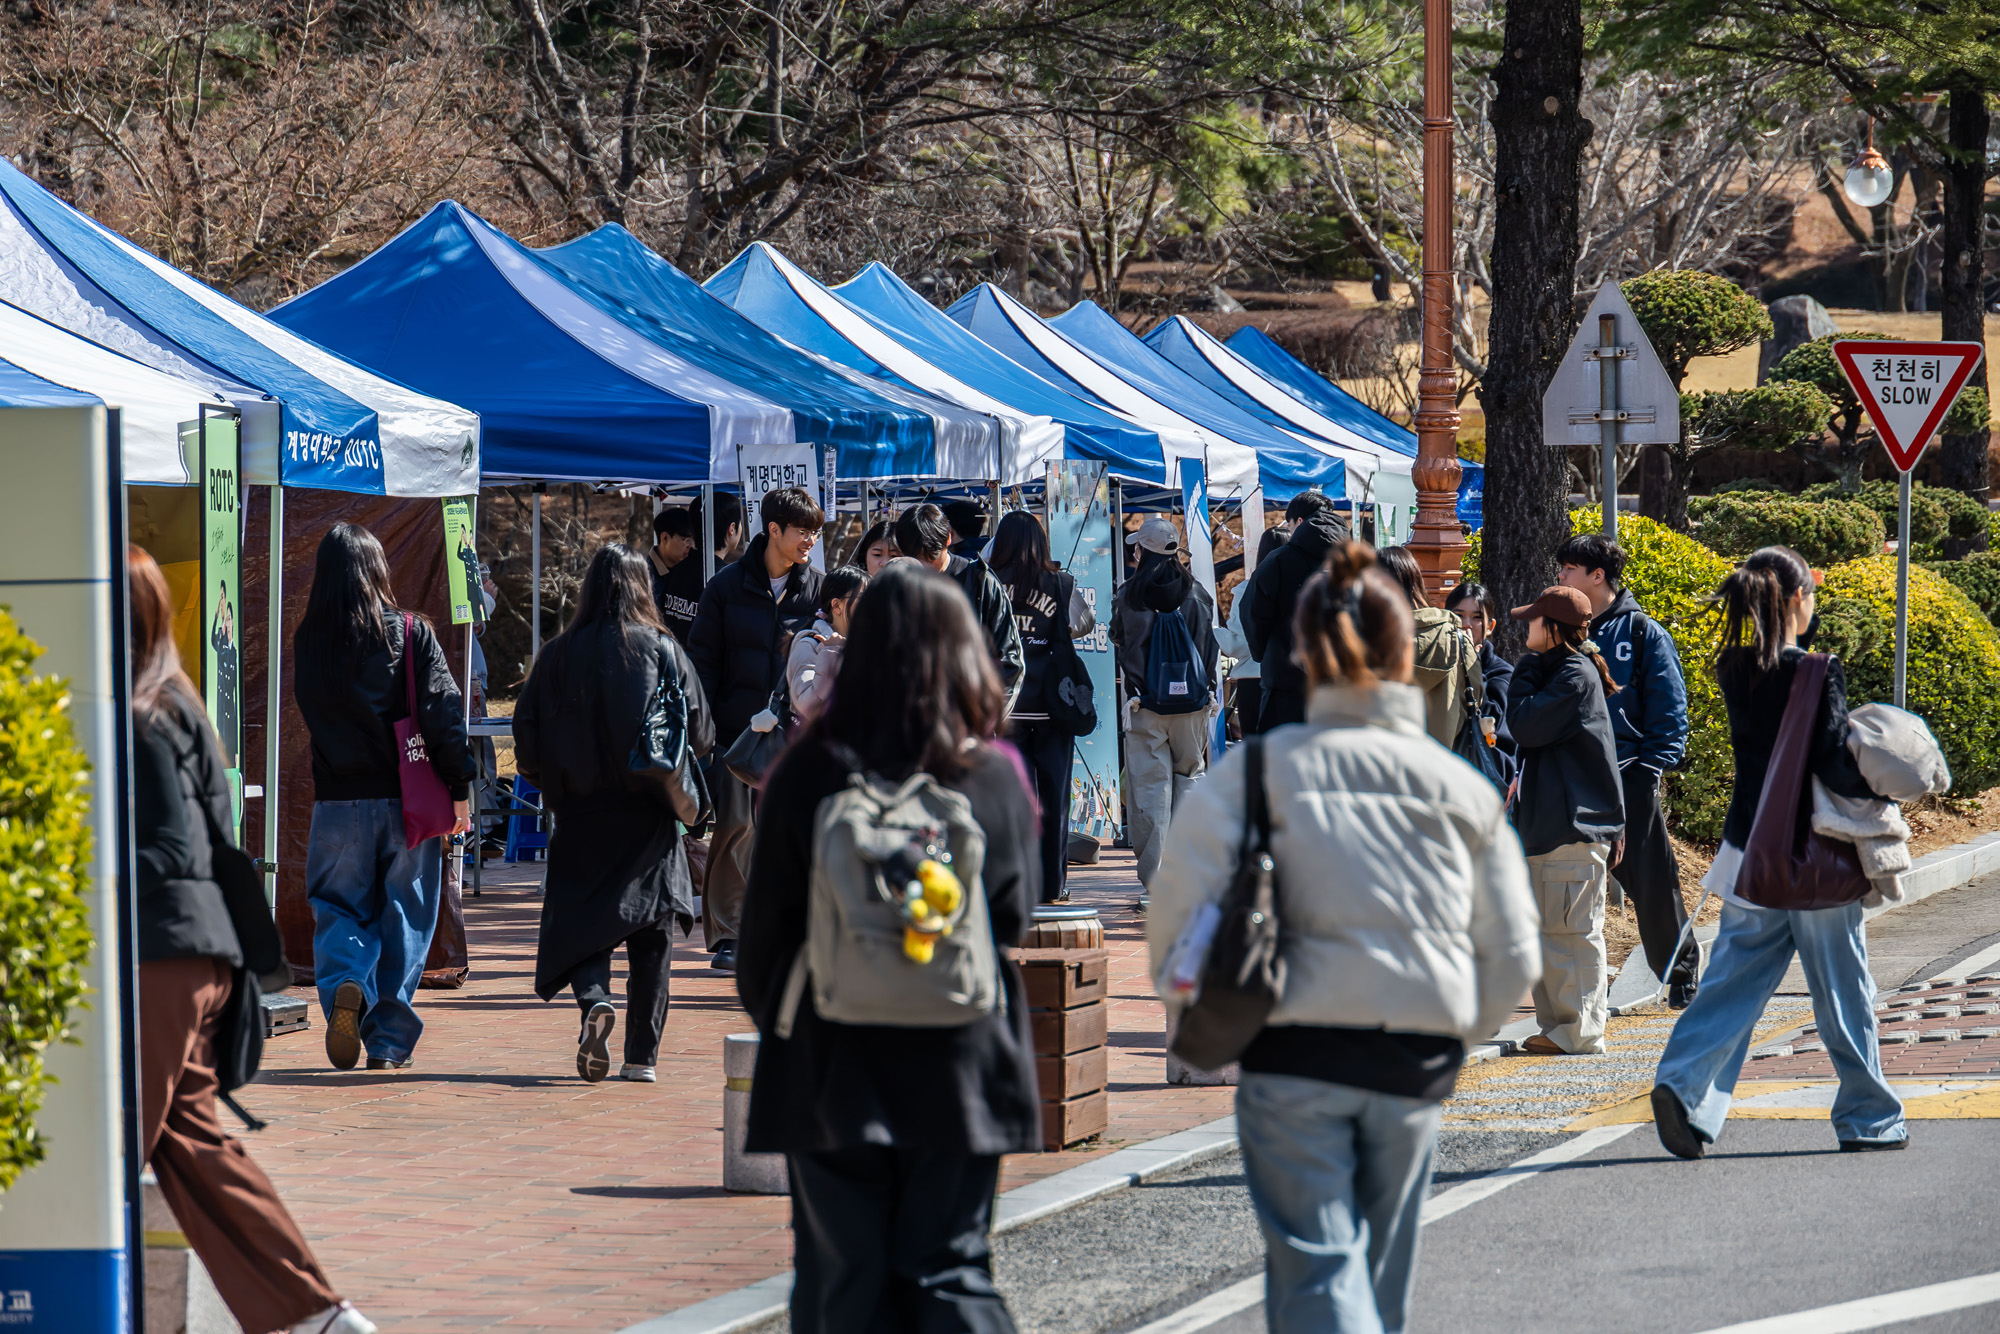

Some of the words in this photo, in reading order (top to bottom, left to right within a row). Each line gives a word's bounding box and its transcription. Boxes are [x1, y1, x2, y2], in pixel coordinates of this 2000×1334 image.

[1872, 358, 1940, 383] 천천히
[1881, 386, 1931, 404] SLOW
[288, 430, 341, 464] 계명대학교
[344, 438, 379, 470] ROTC
[746, 464, 808, 493] 계명대학교
[210, 468, 233, 513] ROTC
[1013, 614, 1036, 632] IV.
[1615, 641, 1632, 661] C
[0, 1289, 34, 1311] 교
